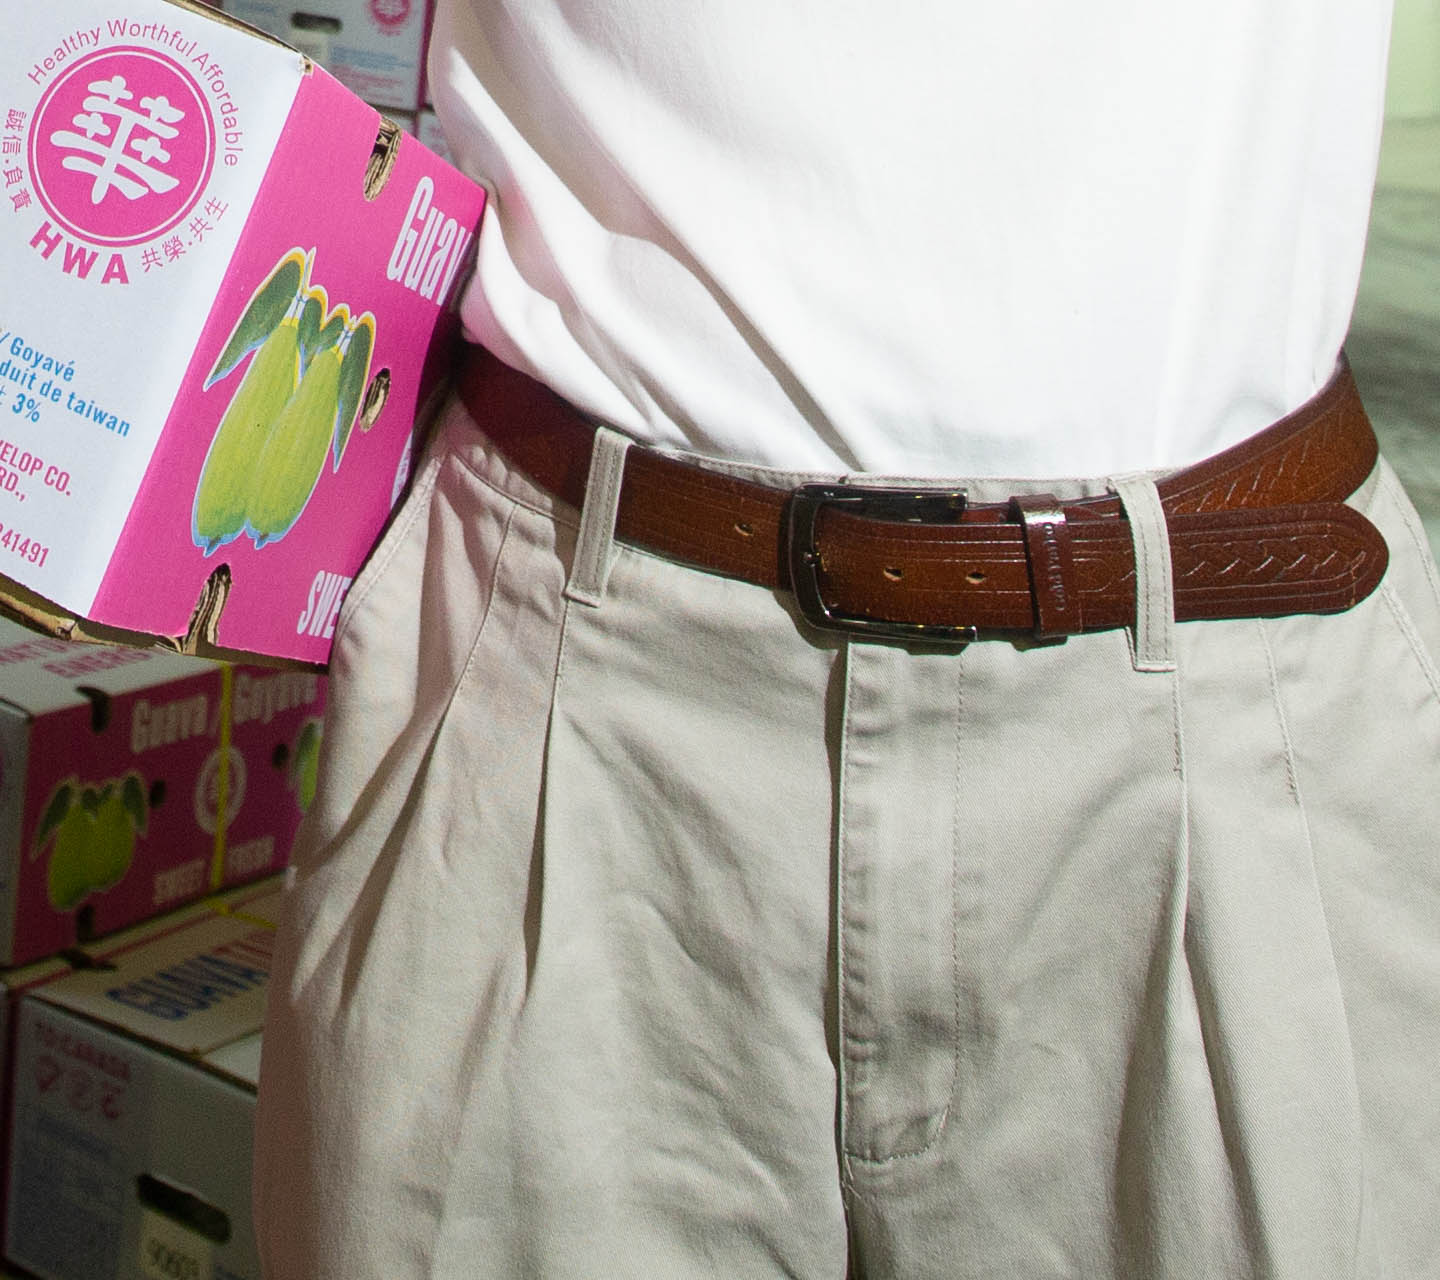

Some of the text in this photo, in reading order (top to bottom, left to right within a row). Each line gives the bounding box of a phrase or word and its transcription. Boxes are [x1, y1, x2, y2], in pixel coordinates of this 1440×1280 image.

[27, 18, 244, 168] Healthy Worthful Affordable
[49, 75, 186, 205] 華
[29, 220, 130, 285] HWA
[386, 176, 474, 306] Guav
[9, 337, 75, 382] Goyavé
[12, 392, 41, 423] 3%
[39, 380, 62, 403] de
[66, 391, 131, 437] taiwan
[43, 465, 72, 496] CO.
[297, 570, 352, 639] SWE
